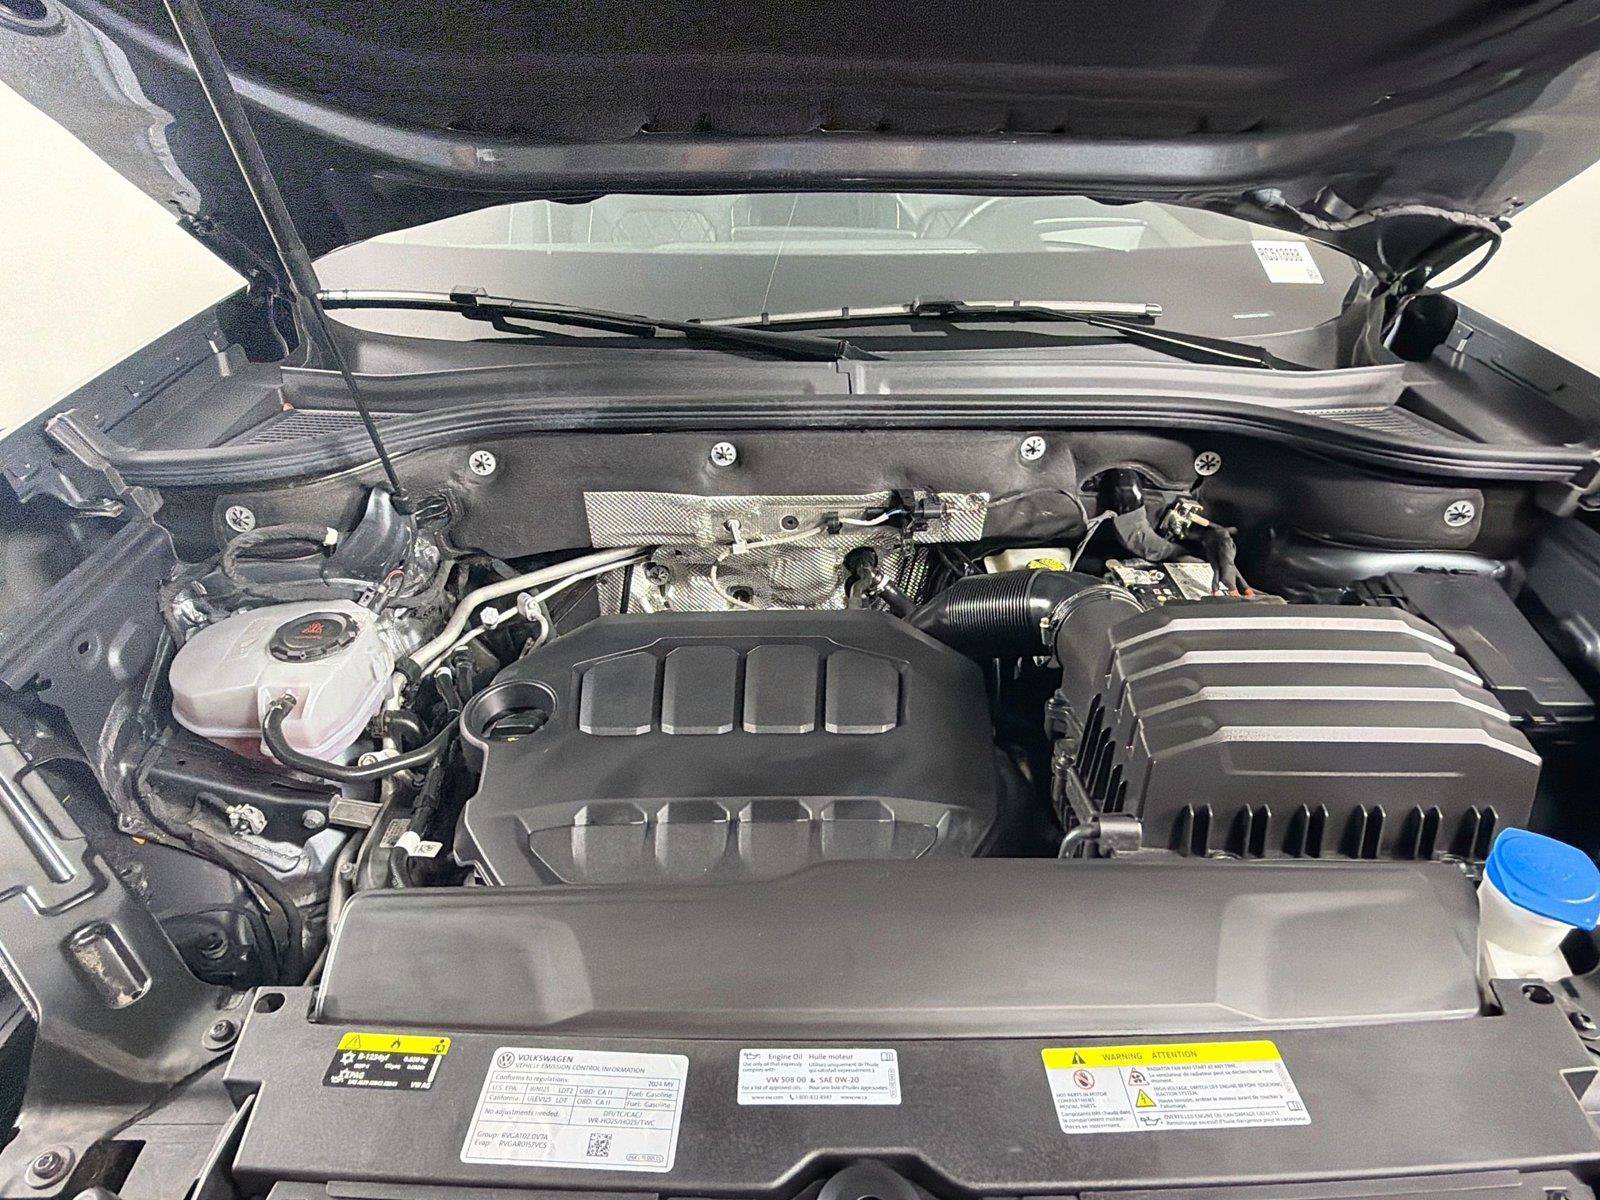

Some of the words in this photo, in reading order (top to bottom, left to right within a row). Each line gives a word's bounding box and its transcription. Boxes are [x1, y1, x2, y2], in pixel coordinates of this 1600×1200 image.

[518, 1054, 574, 1063] VOLKSWAGEN
[768, 1053, 791, 1061] Engine
[1102, 1052, 1143, 1061] WARNING
[1152, 1050, 1198, 1059] ATTENTION
[601, 1065, 646, 1074] INFORMATION
[648, 1080, 662, 1088] 2024
[766, 1076, 780, 1084] VW
[781, 1076, 795, 1084] 508
[796, 1076, 806, 1084] 00
[819, 1076, 833, 1084] SAE
[834, 1076, 860, 1084] 0W-20
[504, 1084, 517, 1092] EPA
[597, 1088, 607, 1096] CA
[645, 1091, 673, 1099] Gasoline
[644, 1101, 671, 1109] Gasoline
[484, 1107, 494, 1115] No
[494, 1108, 534, 1117] adjustments
